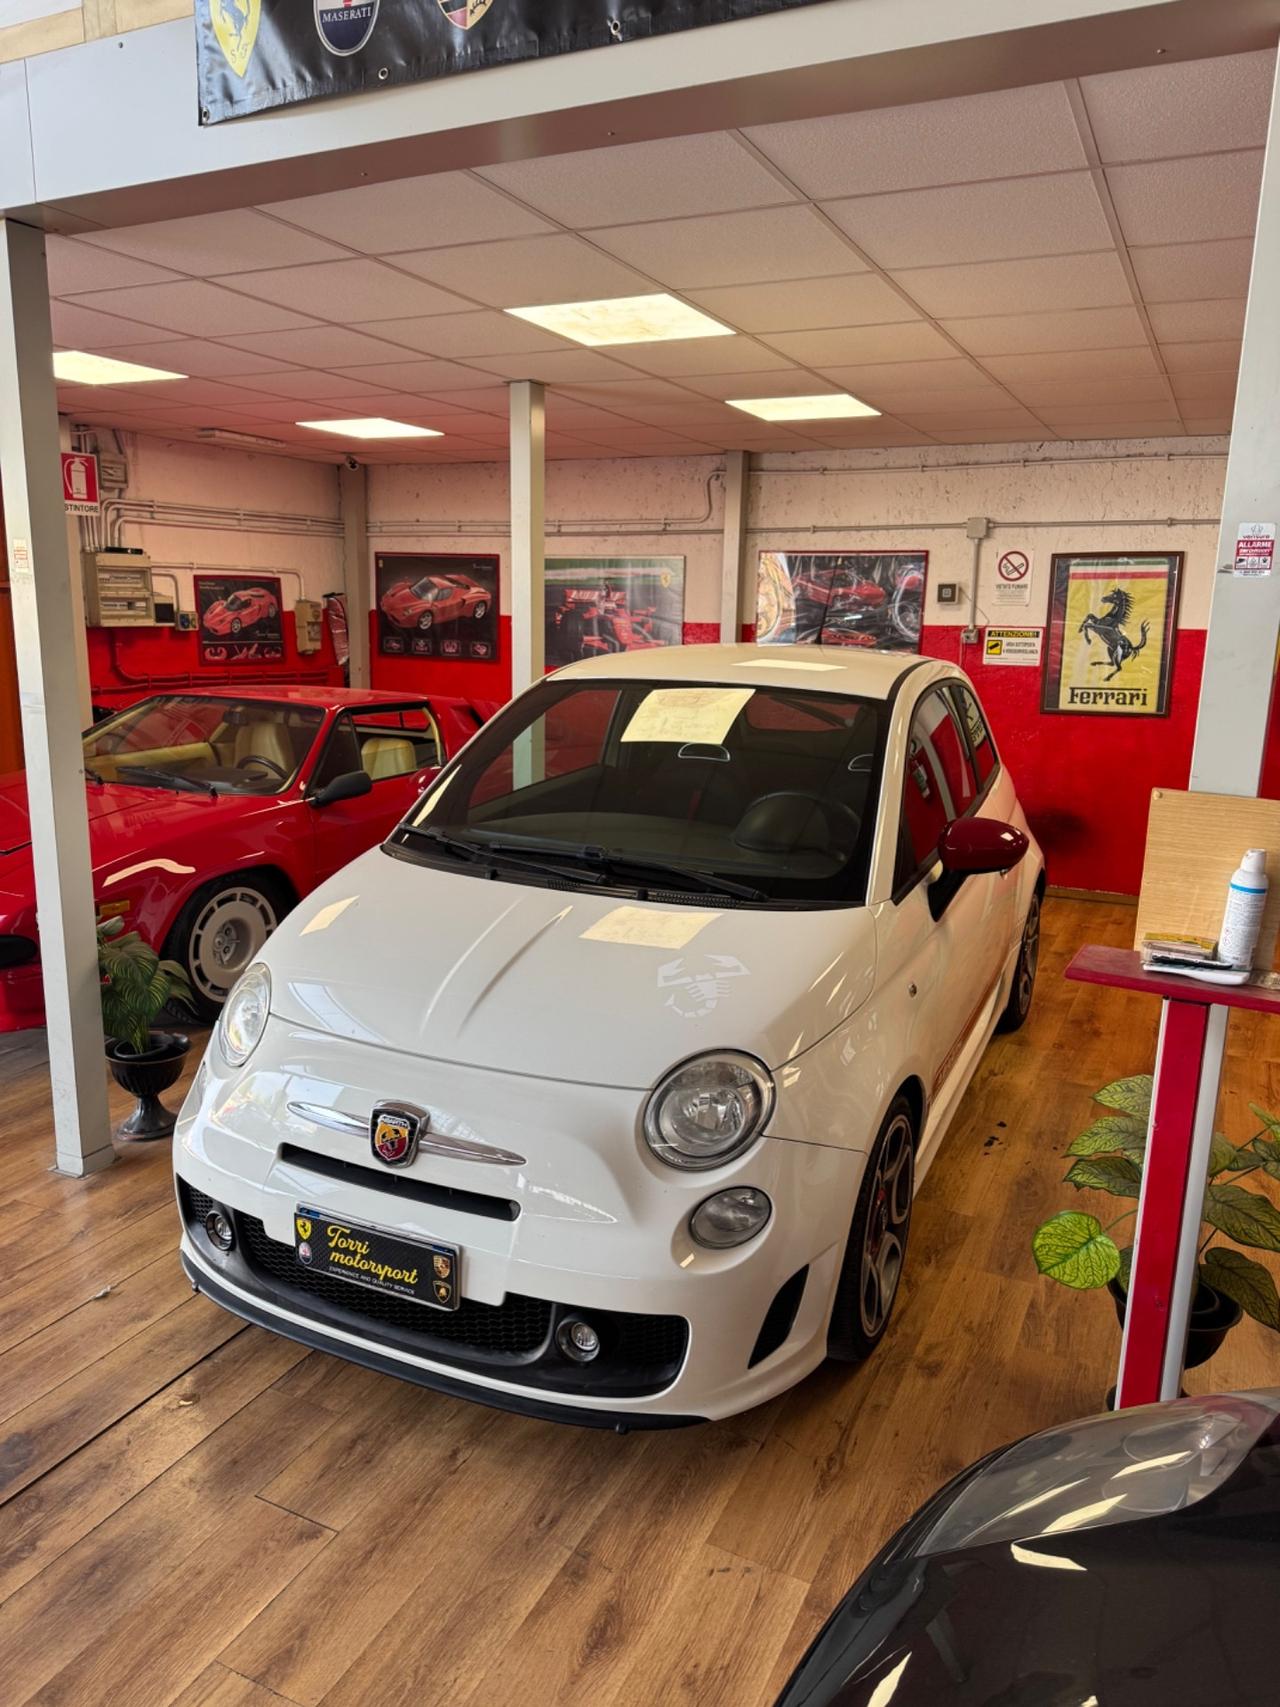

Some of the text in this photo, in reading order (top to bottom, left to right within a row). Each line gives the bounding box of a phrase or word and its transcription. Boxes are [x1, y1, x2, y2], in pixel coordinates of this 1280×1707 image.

[322, 7, 372, 23] MASERATI
[64, 503, 99, 513] STINTORE
[1067, 687, 1148, 706] Ferrari
[327, 1225, 370, 1254] Torri
[329, 1251, 418, 1284] motorsport
[328, 1265, 360, 1279] EXPERIENCE
[371, 1278, 393, 1289] QUALITY
[393, 1283, 415, 1295] SERVICE
